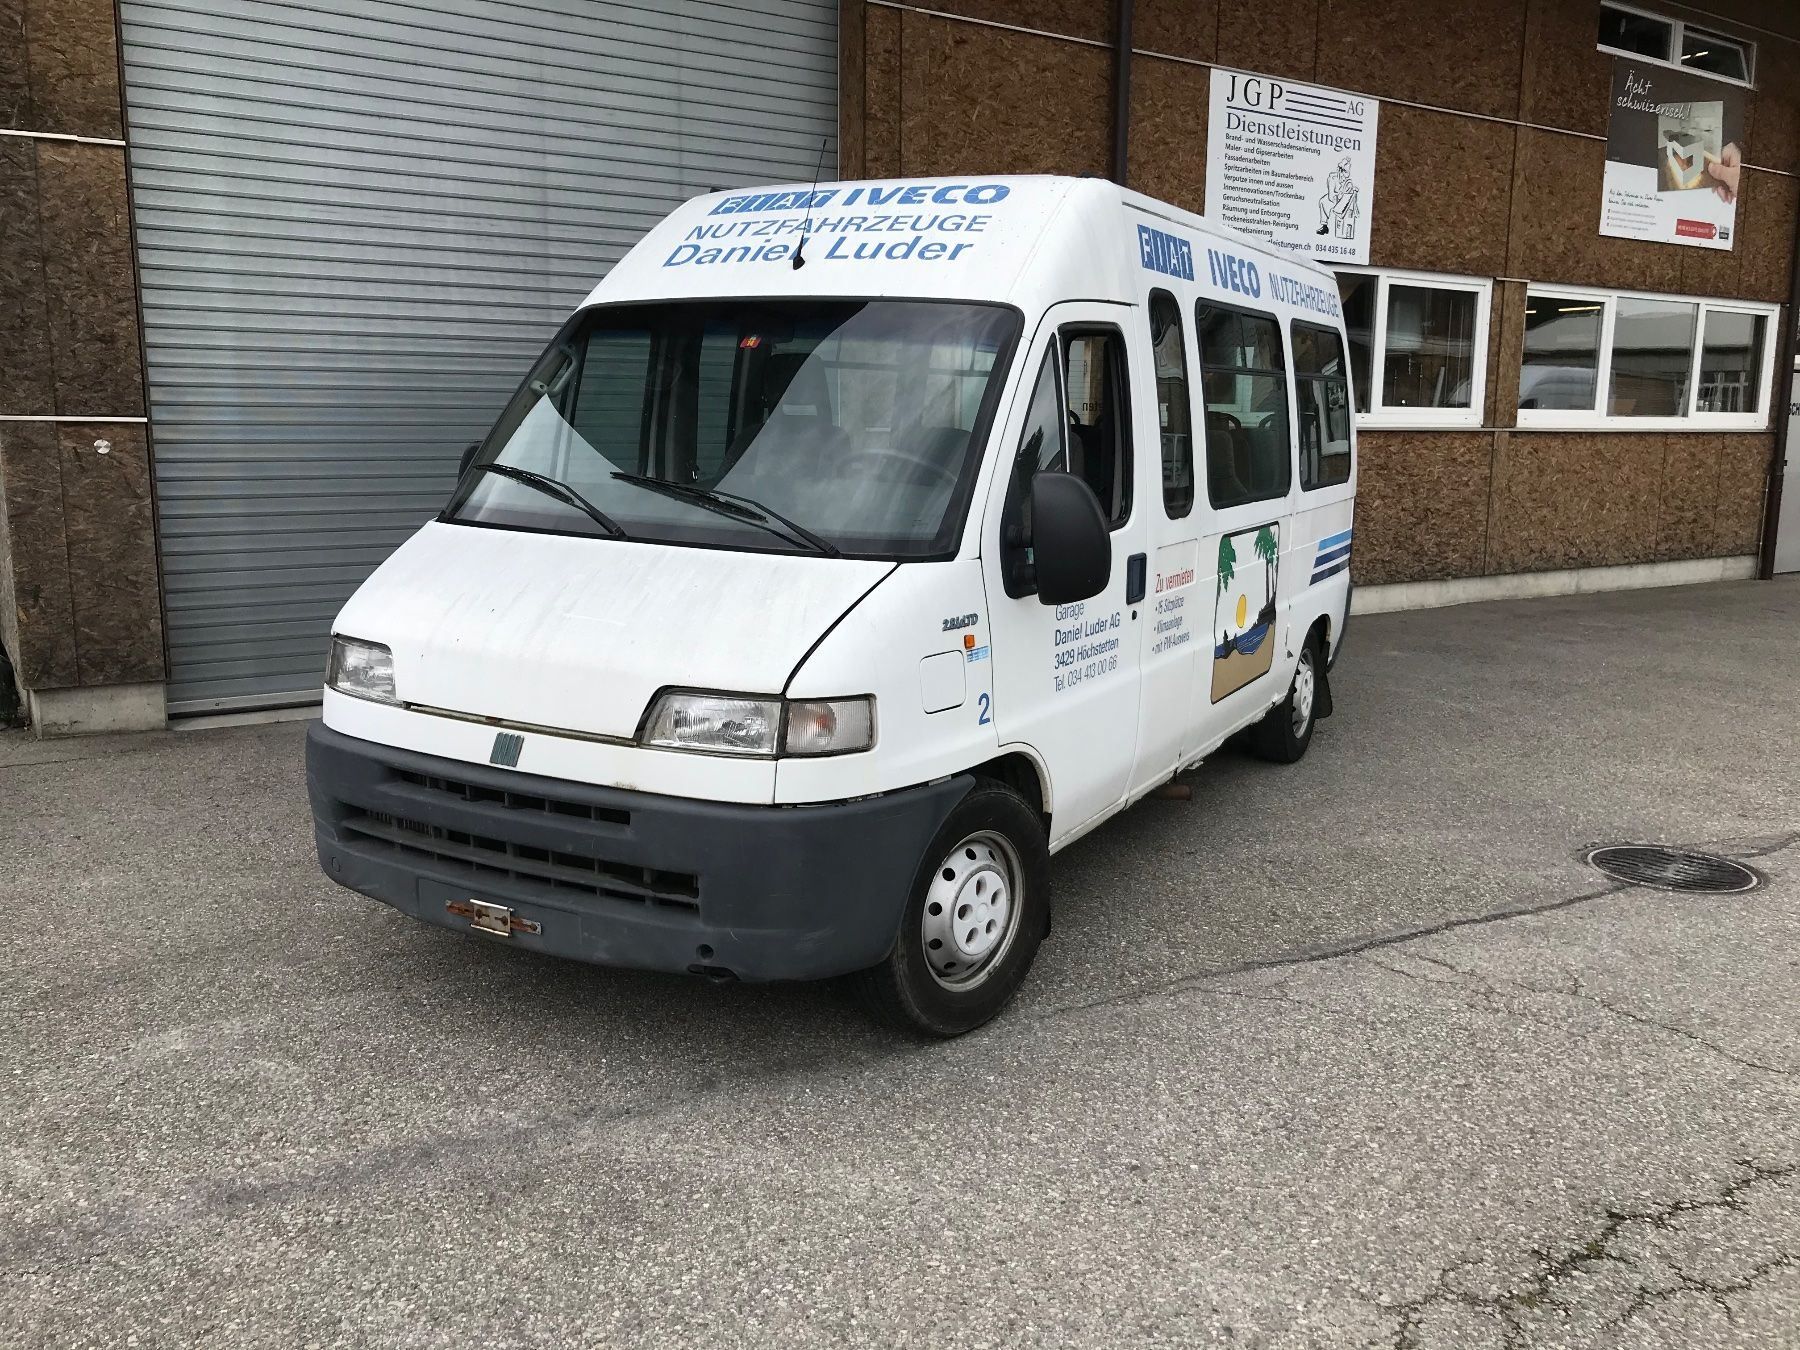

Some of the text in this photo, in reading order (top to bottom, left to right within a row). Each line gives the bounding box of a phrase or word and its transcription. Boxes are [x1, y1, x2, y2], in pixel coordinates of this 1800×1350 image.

[1624, 70, 1653, 95] Ächt
[1347, 100, 1364, 116] AG
[1225, 133, 1244, 142] Brand-
[1257, 138, 1321, 156] Wasserschadensanierung
[1226, 112, 1361, 152] Dienstleistungen
[1224, 153, 1270, 166] Fassadenarbeiten
[1225, 143, 1242, 152] Maler-
[1256, 148, 1294, 160] Gipserarbeiten
[1224, 163, 1262, 175] Spritzarbeiten
[1224, 174, 1247, 183] Verputze
[1249, 177, 1264, 185] innen
[707, 184, 1011, 216] FIAT IVECO
[1222, 194, 1280, 207] Geruchsneutralisation
[1222, 204, 1248, 215] Räumung
[1261, 209, 1291, 220] Entsorgung
[684, 214, 993, 241] NUTZFAHRZEUGE
[662, 236, 974, 268] Daniel Luder
[1315, 243, 1327, 252] 034
[1328, 245, 1339, 254] 435
[1340, 246, 1347, 255] 16
[1348, 248, 1356, 256] 48
[1137, 224, 1340, 318] FIAT IVECO NUTZFAHRZEUGE
[1155, 568, 1194, 593] Zu vermieten
[1055, 602, 1085, 621] Garage
[1055, 612, 1120, 647] Daniel Luder AG
[1054, 638, 1119, 670] 3429 Höchstetten
[1053, 654, 1118, 692] Tel. 034 413 00 66
[978, 693, 990, 725] 2
